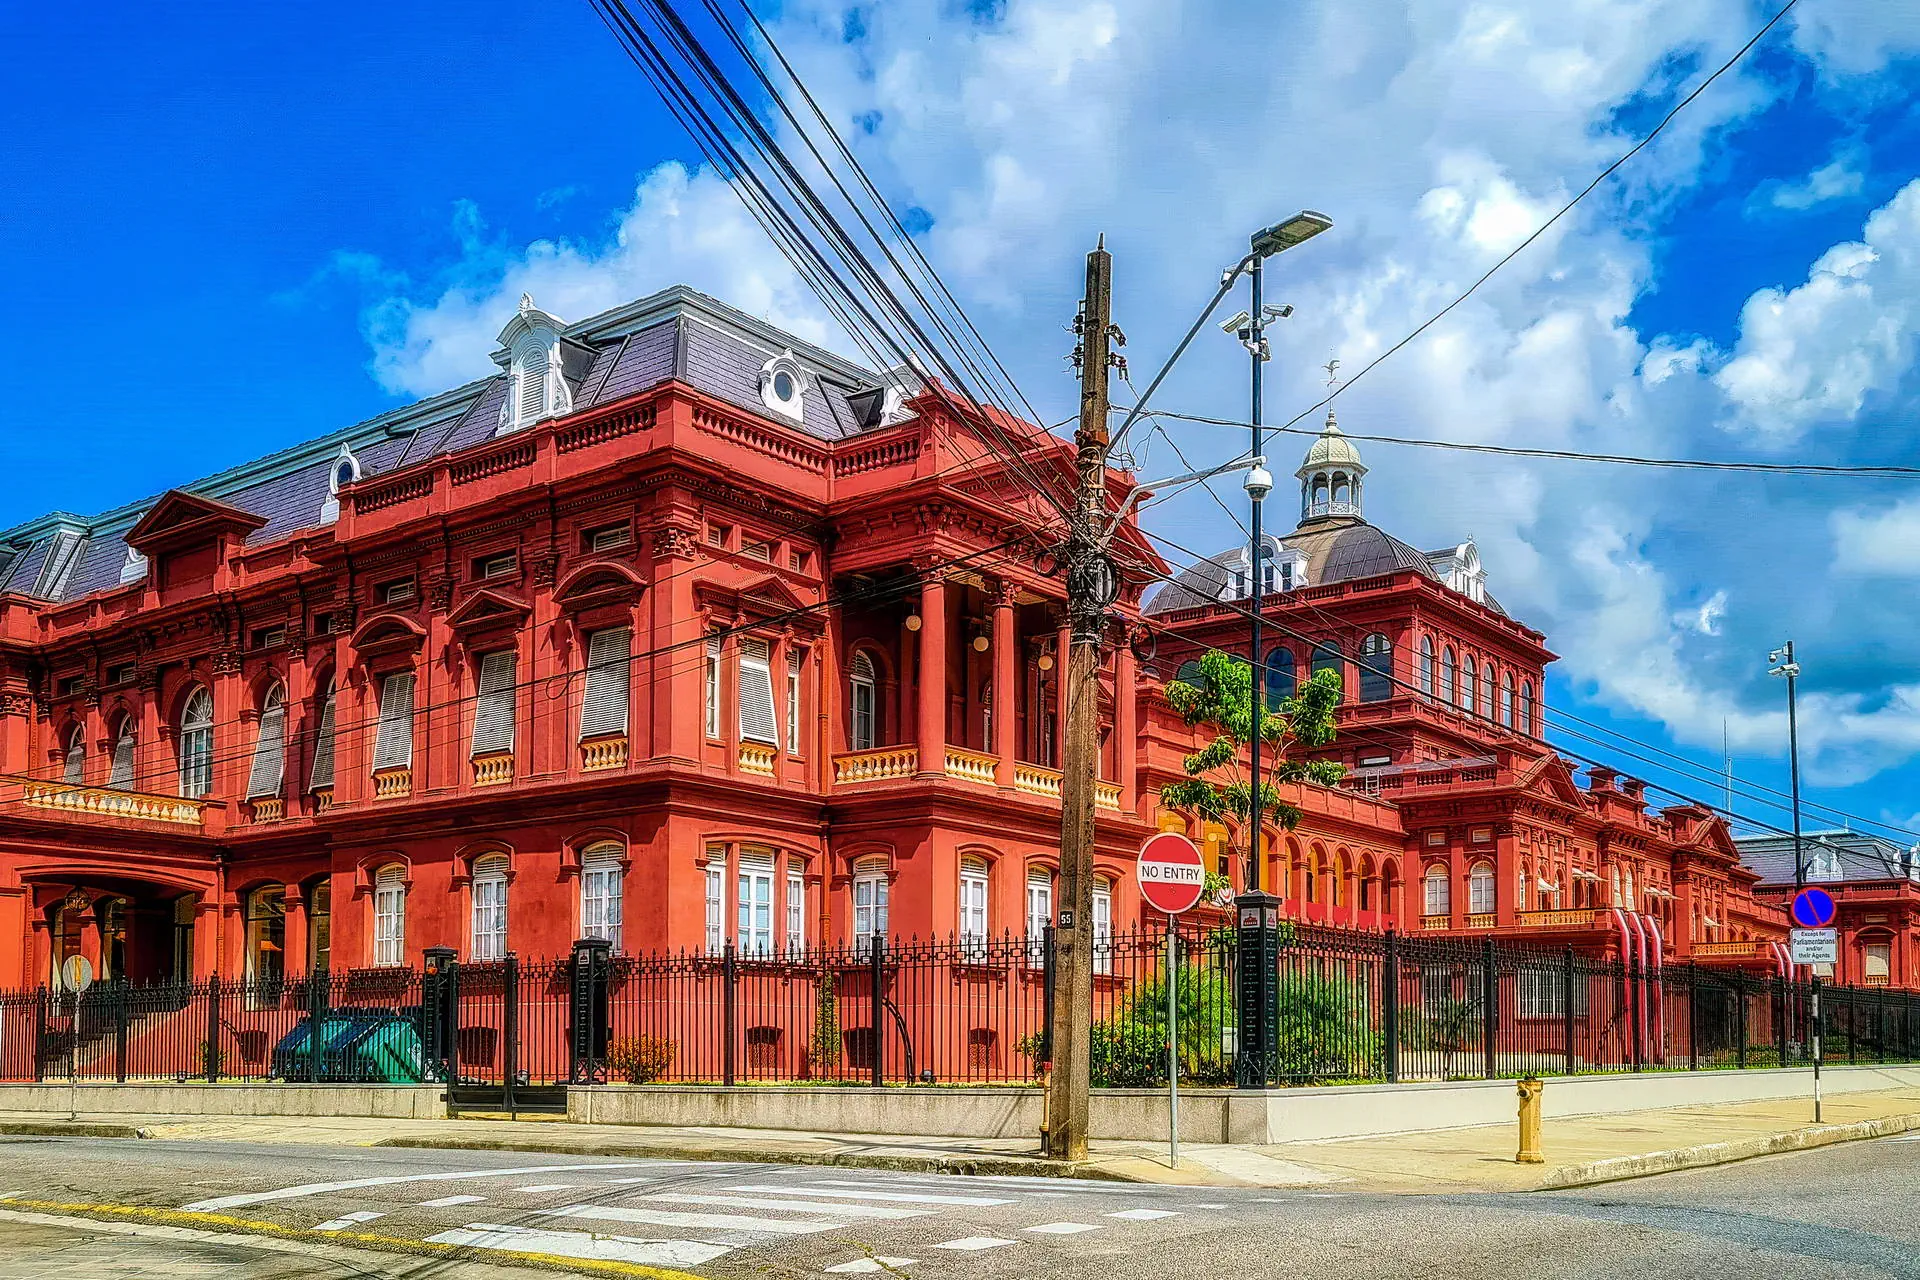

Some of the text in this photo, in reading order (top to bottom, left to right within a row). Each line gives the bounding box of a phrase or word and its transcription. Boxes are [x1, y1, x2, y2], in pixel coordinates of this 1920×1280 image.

[1142, 865, 1200, 881] NO ENTRY
[1061, 914, 1071, 924] 55
